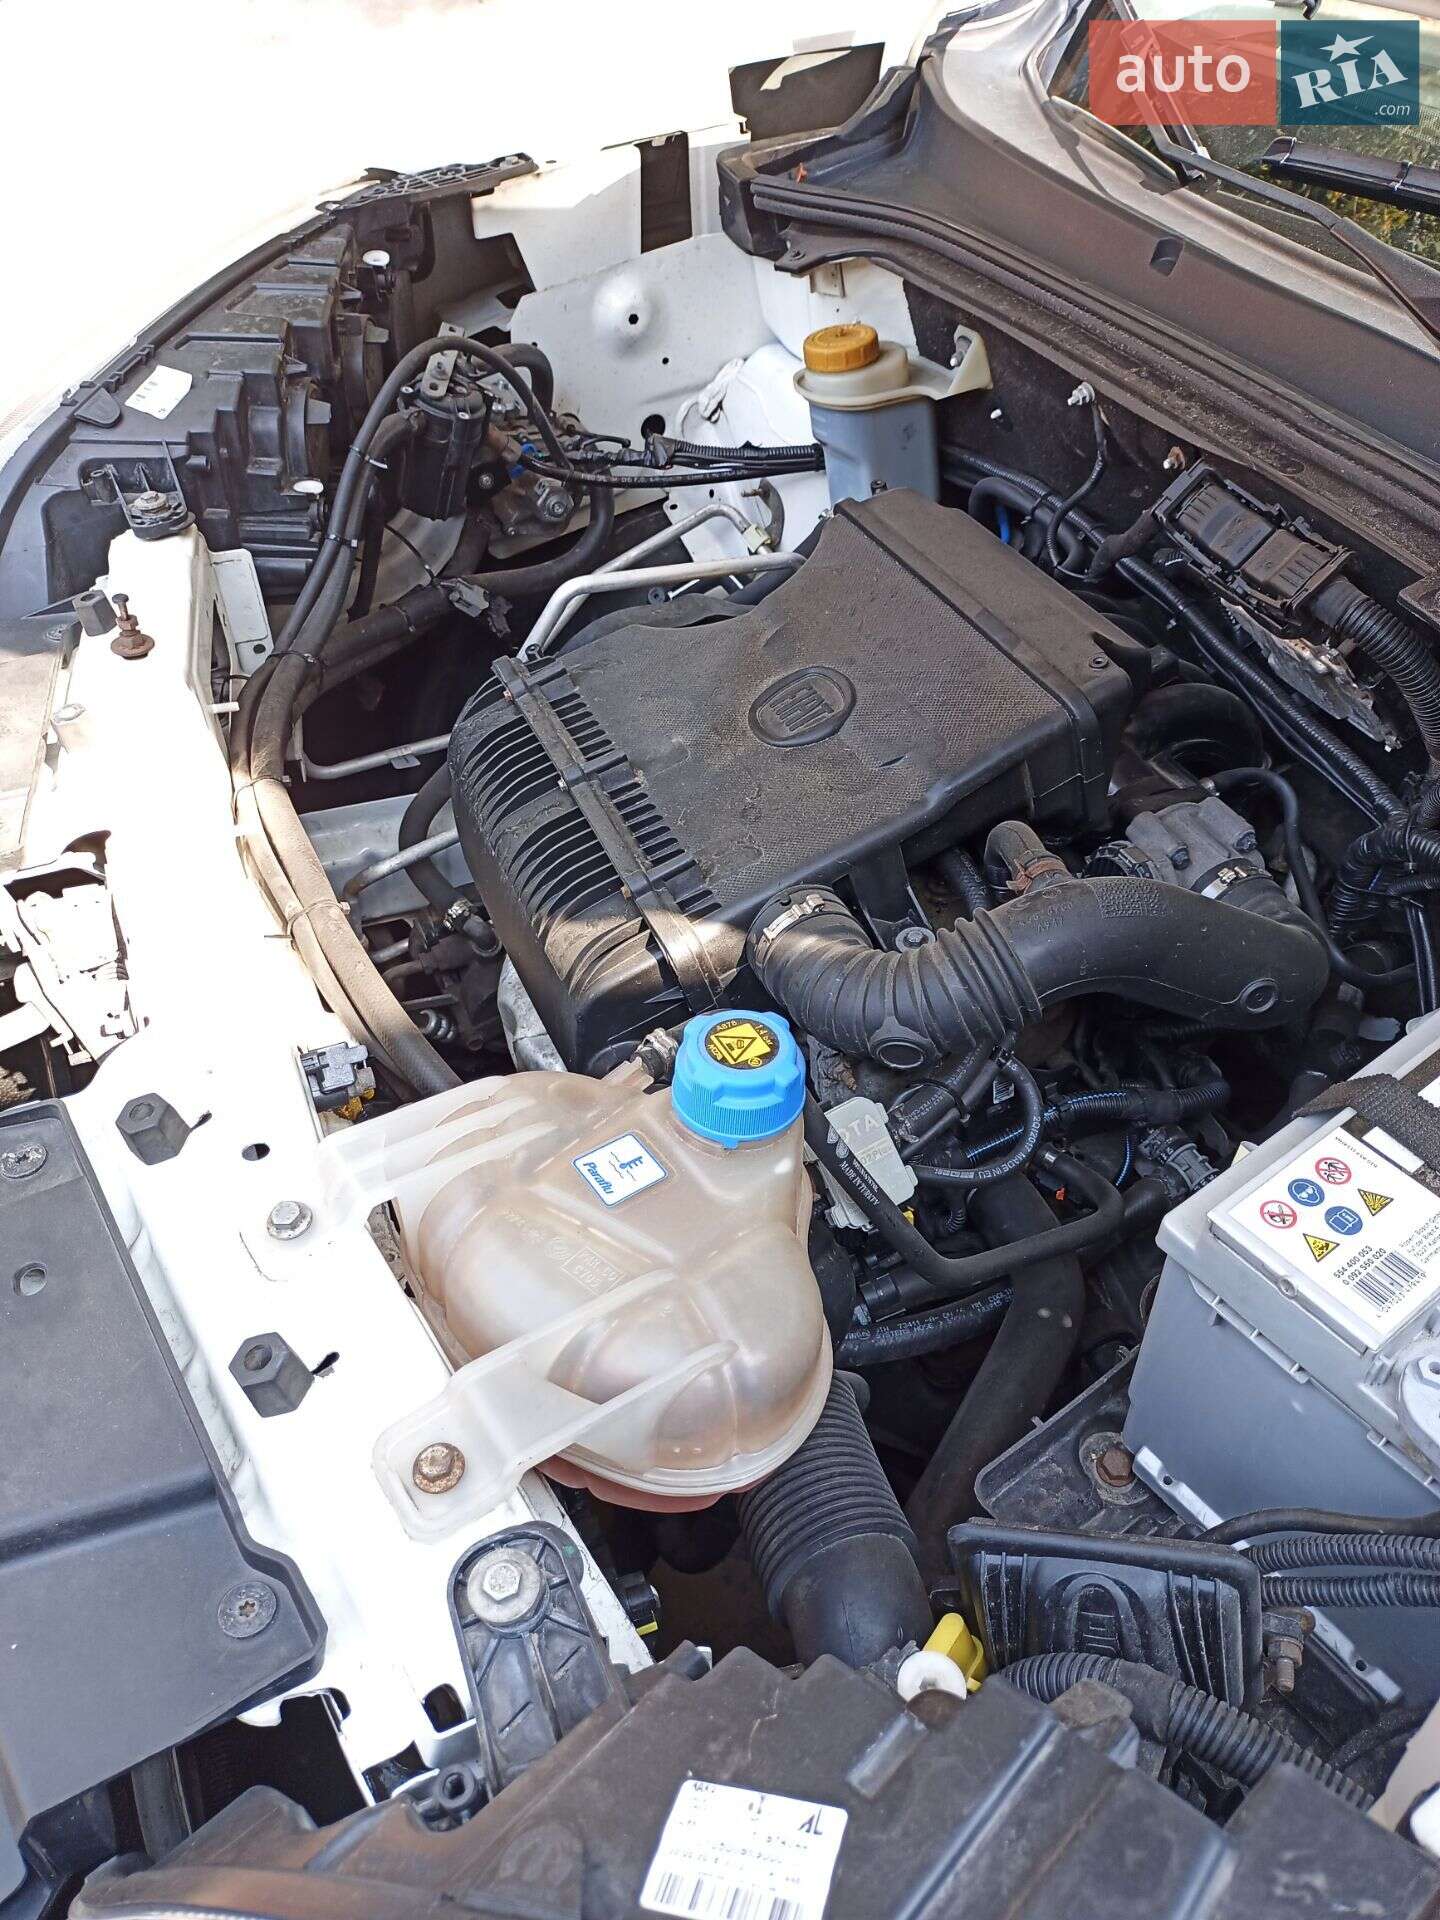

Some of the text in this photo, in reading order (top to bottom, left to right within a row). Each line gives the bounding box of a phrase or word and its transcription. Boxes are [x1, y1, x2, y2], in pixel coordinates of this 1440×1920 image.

[769, 684, 836, 732] FIAT
[583, 1161, 615, 1195] Paraflu
[839, 1160, 857, 1180] MADE
[852, 1176, 863, 1187] IN
[1333, 1245, 1373, 1279] 554 400 053
[1342, 1278, 1350, 1286] 0
[1347, 1269, 1362, 1281] 092
[1372, 1247, 1387, 1260] 020
